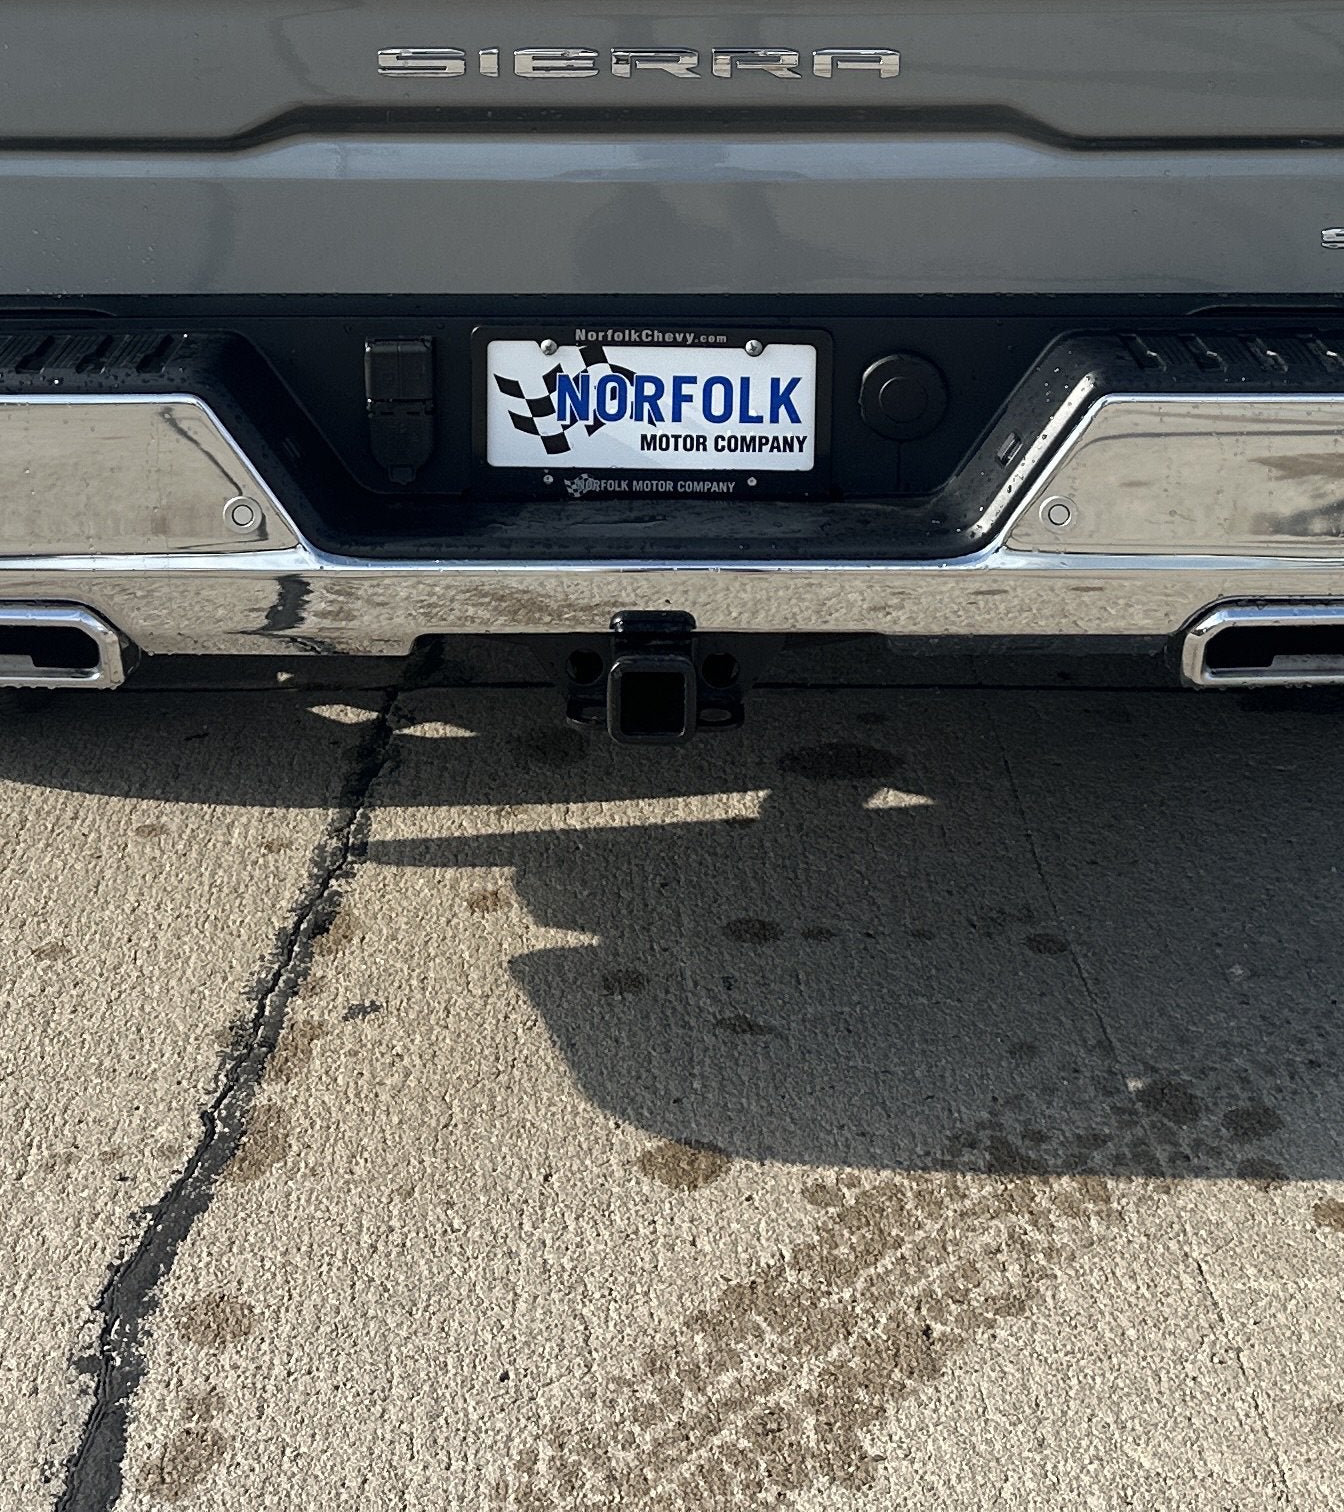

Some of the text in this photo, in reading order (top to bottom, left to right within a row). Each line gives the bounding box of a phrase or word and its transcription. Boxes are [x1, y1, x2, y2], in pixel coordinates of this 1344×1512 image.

[377, 47, 900, 79] SIERRA
[575, 329, 727, 344] NorfolkChevy.com
[556, 373, 803, 424] NORFOLK
[640, 434, 807, 454] MOTOR COMPANY
[575, 479, 736, 493] NORFOLK MOTOR COMPANY
